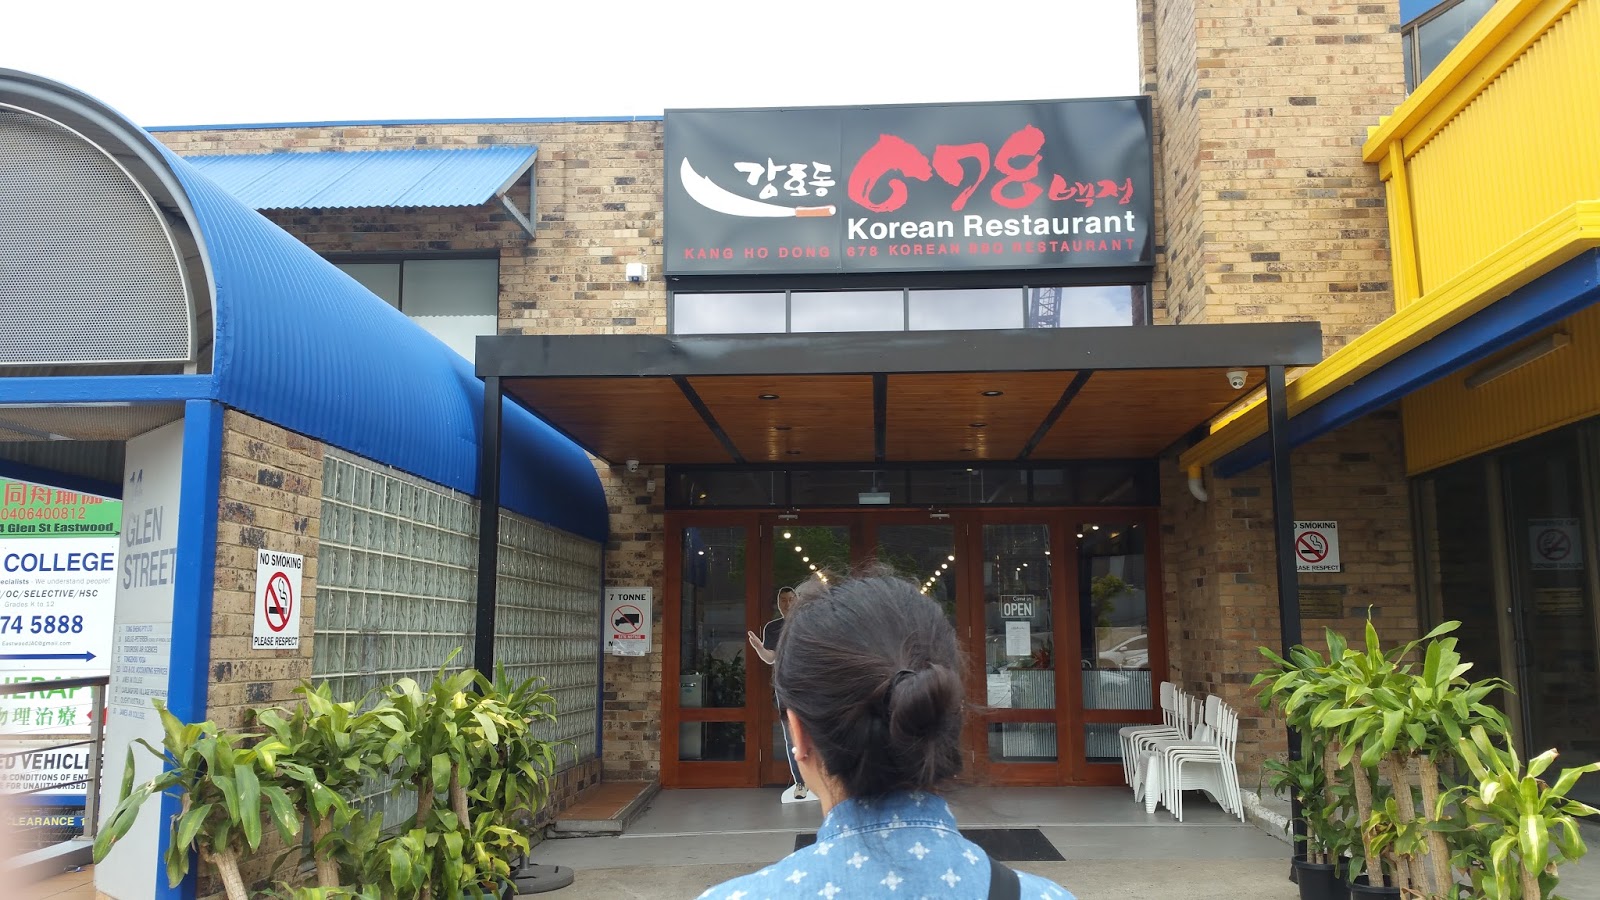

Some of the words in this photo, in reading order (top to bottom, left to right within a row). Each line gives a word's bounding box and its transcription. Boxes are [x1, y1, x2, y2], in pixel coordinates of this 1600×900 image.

[733, 157, 836, 199] 강호동
[848, 124, 1046, 214] 678
[1047, 173, 1134, 208] 백정
[848, 217, 954, 240] Korean
[964, 210, 1136, 238] Restaurant
[684, 247, 735, 260] KANG
[744, 247, 769, 259] HO
[778, 245, 831, 259] DONG
[847, 245, 879, 257] 678
[889, 242, 960, 256] KOREAN
[1014, 238, 1136, 253] RESTAURANT
[1, 506, 86, 520] 0406400812
[8, 523, 36, 533] Glen
[39, 523, 51, 532] St
[54, 522, 113, 532] Eastwood
[126, 505, 163, 548] GLEN
[4, 552, 114, 572] COLLEGE
[123, 547, 176, 590] STREET
[260, 552, 270, 565] NO
[271, 554, 302, 569] SMOKING
[0, 589, 99, 599] /OC/SELECTIVE/HSC
[1004, 603, 1032, 616] OPEN
[30, 615, 84, 634] 5888
[254, 636, 274, 646] PLEASE
[275, 636, 298, 646] RESPECT
[22, 753, 104, 770] VEHICL
[10, 773, 58, 781] CONDITIONS
[60, 773, 71, 781] OF
